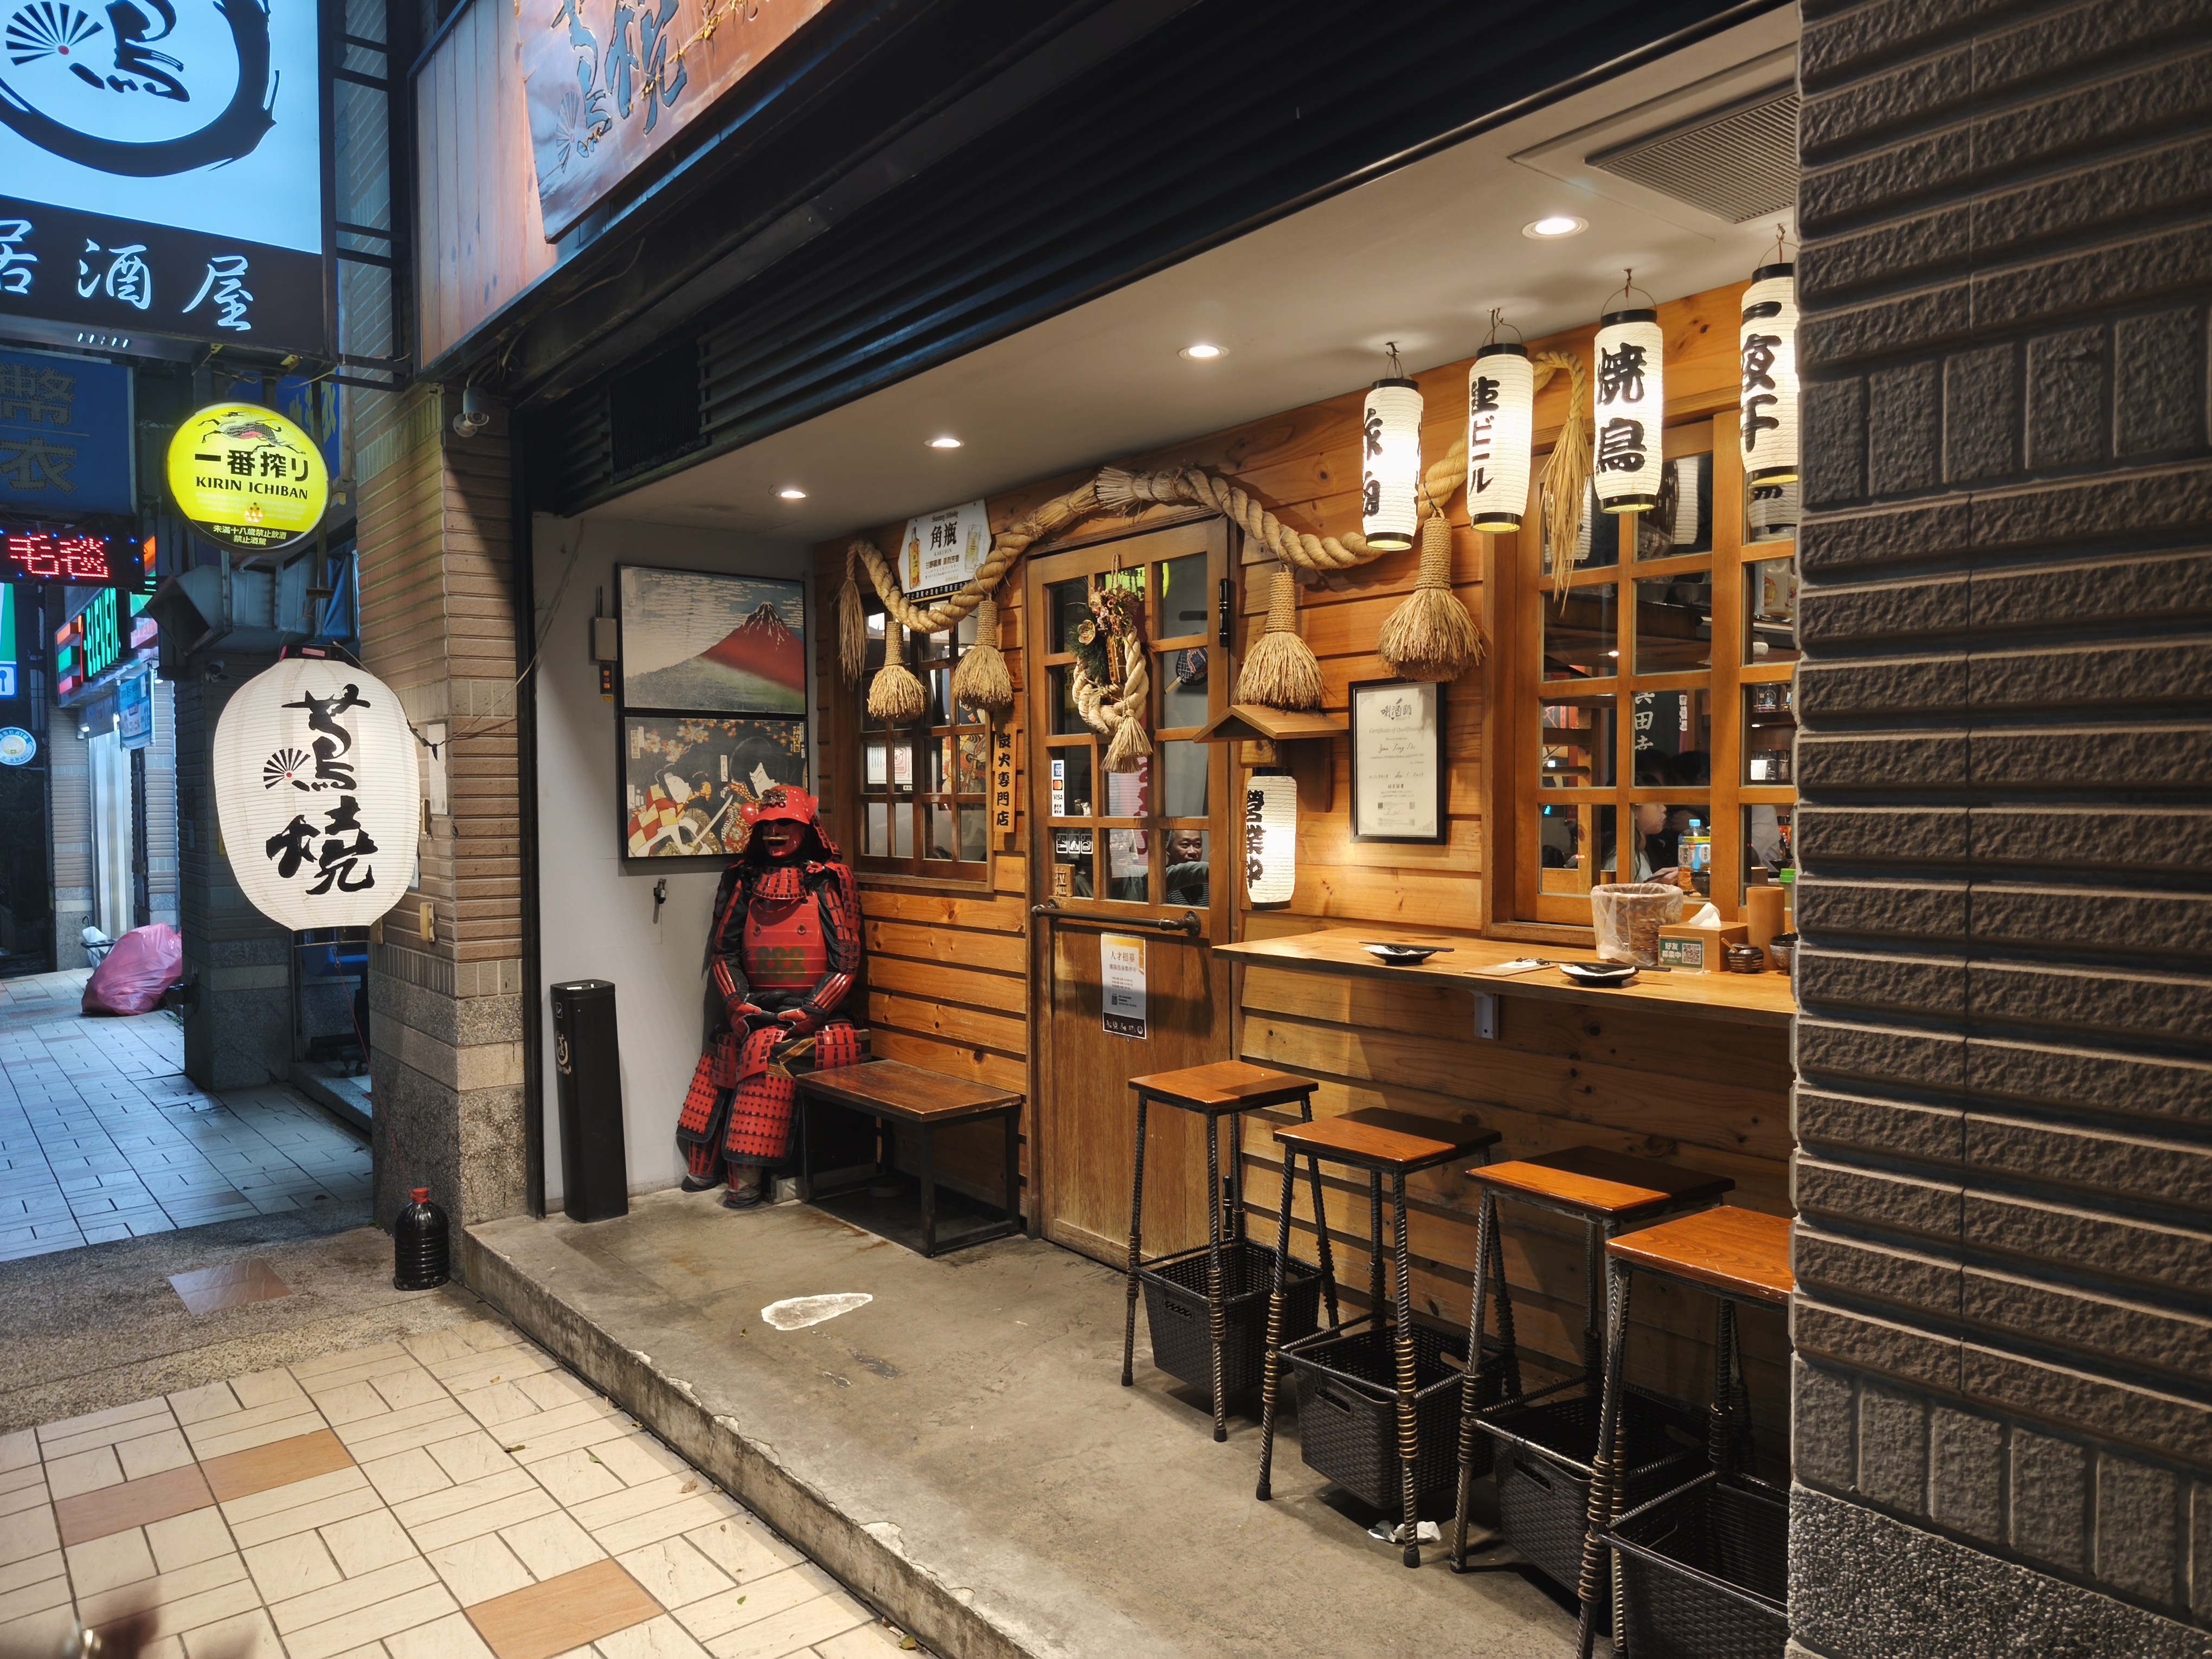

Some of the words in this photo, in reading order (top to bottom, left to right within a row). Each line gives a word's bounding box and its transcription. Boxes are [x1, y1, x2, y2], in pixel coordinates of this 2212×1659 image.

[1468, 376, 1500, 497] 生ビール
[195, 449, 308, 482] 一番搾り
[196, 476, 241, 491] KIRIN
[249, 482, 308, 499] ICHIBAN
[930, 521, 957, 551] 角瓶
[9, 534, 108, 578] 毛毯
[996, 732, 1011, 826] 炭火專門店
[1111, 950, 1135, 962] 人才招募
[1665, 942, 1679, 950] 好友
